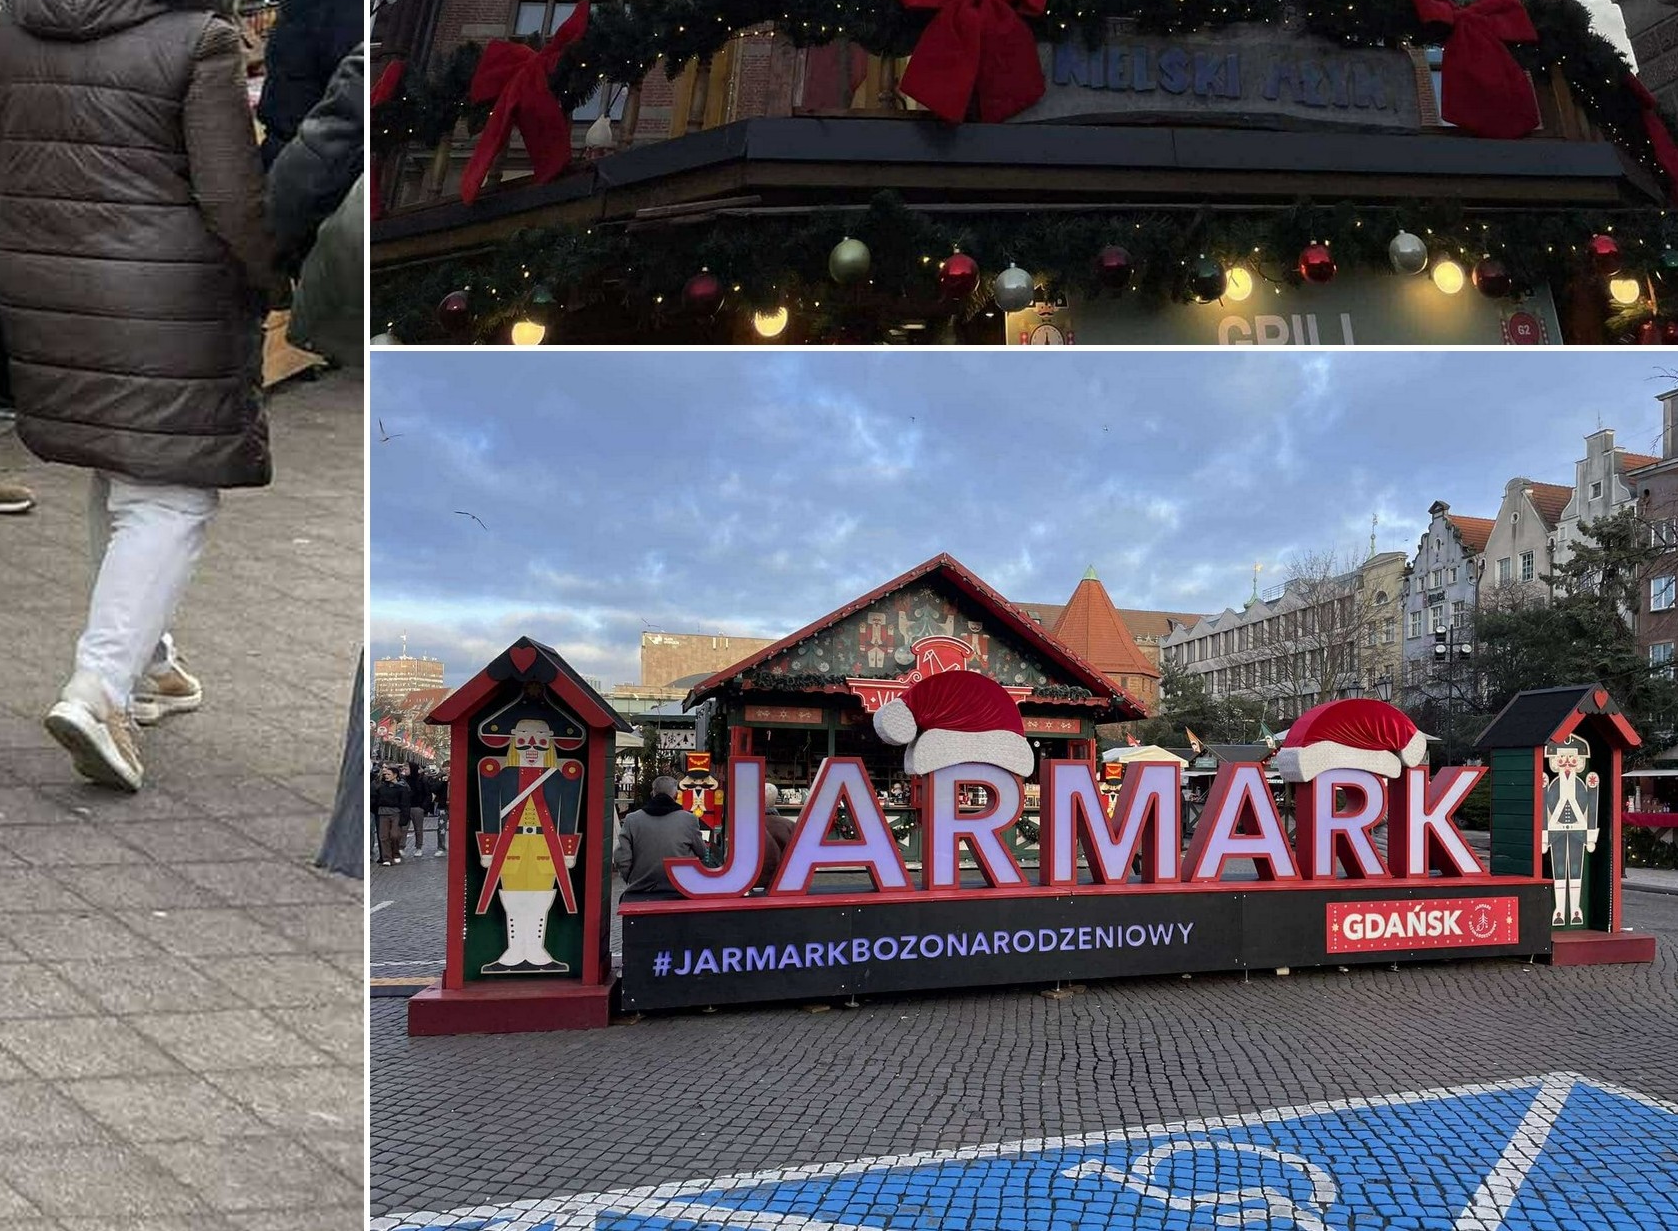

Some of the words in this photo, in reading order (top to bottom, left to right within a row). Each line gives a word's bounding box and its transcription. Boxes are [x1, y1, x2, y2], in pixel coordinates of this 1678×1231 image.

[663, 755, 1490, 900] JARMARK
[652, 921, 1195, 977] #JARMARKBOZONARODZENIOWY
[1343, 904, 1463, 941] GDAŃSK
